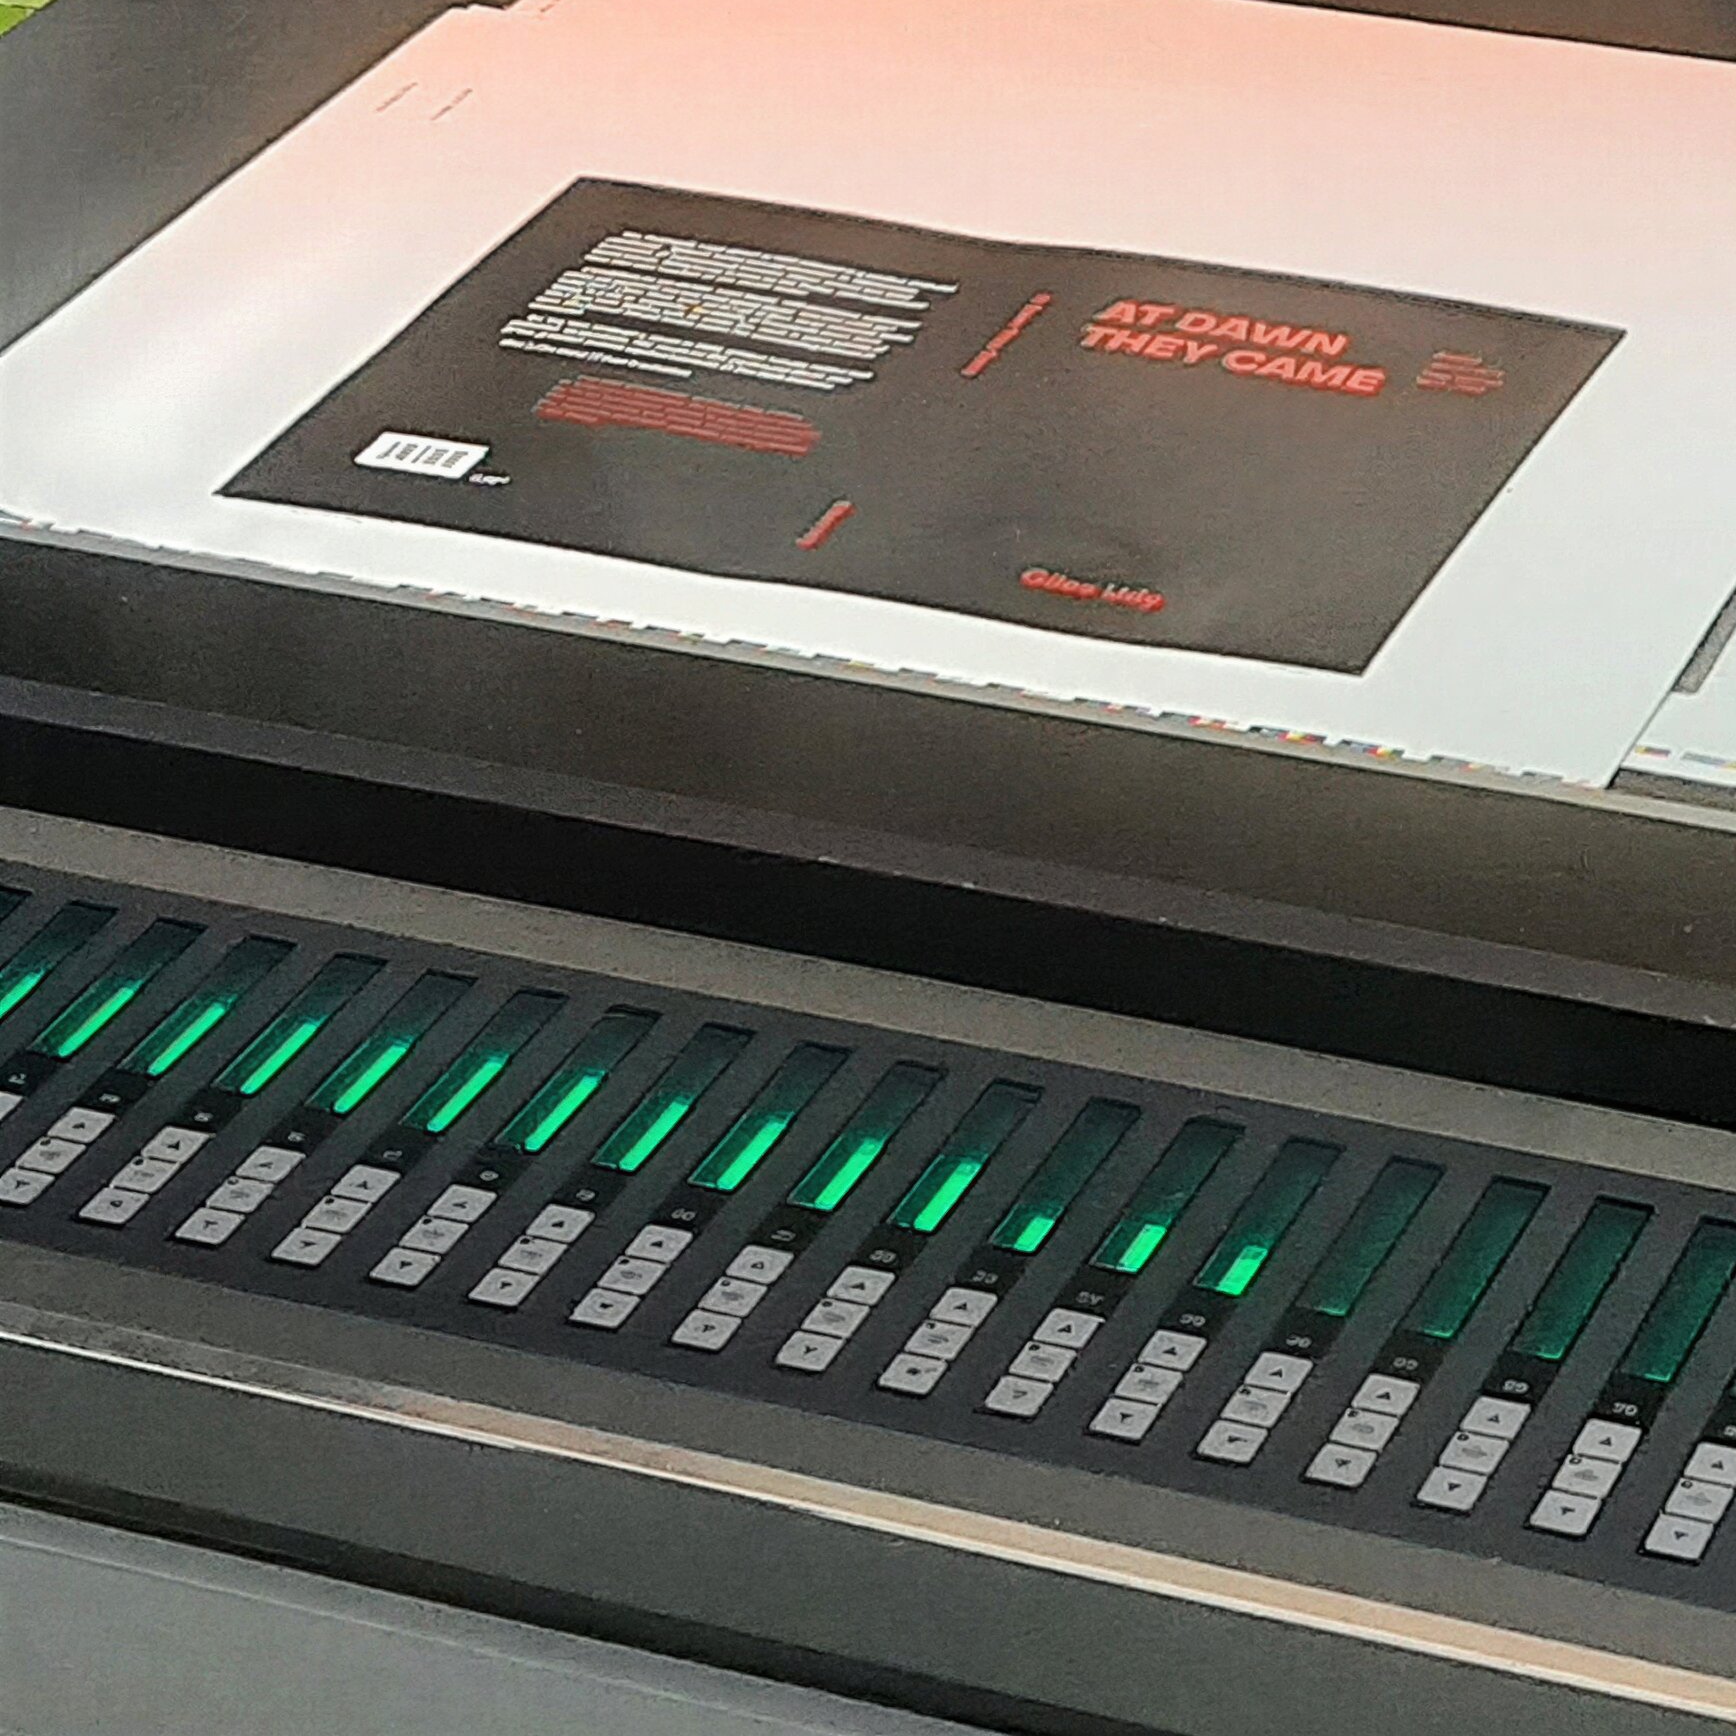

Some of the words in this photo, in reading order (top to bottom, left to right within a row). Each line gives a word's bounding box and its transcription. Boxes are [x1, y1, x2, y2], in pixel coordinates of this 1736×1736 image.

[1098, 299, 1174, 326] AT
[1175, 311, 1349, 356] DAWN
[1080, 325, 1219, 364] THEY
[1221, 350, 1386, 394] CAME
